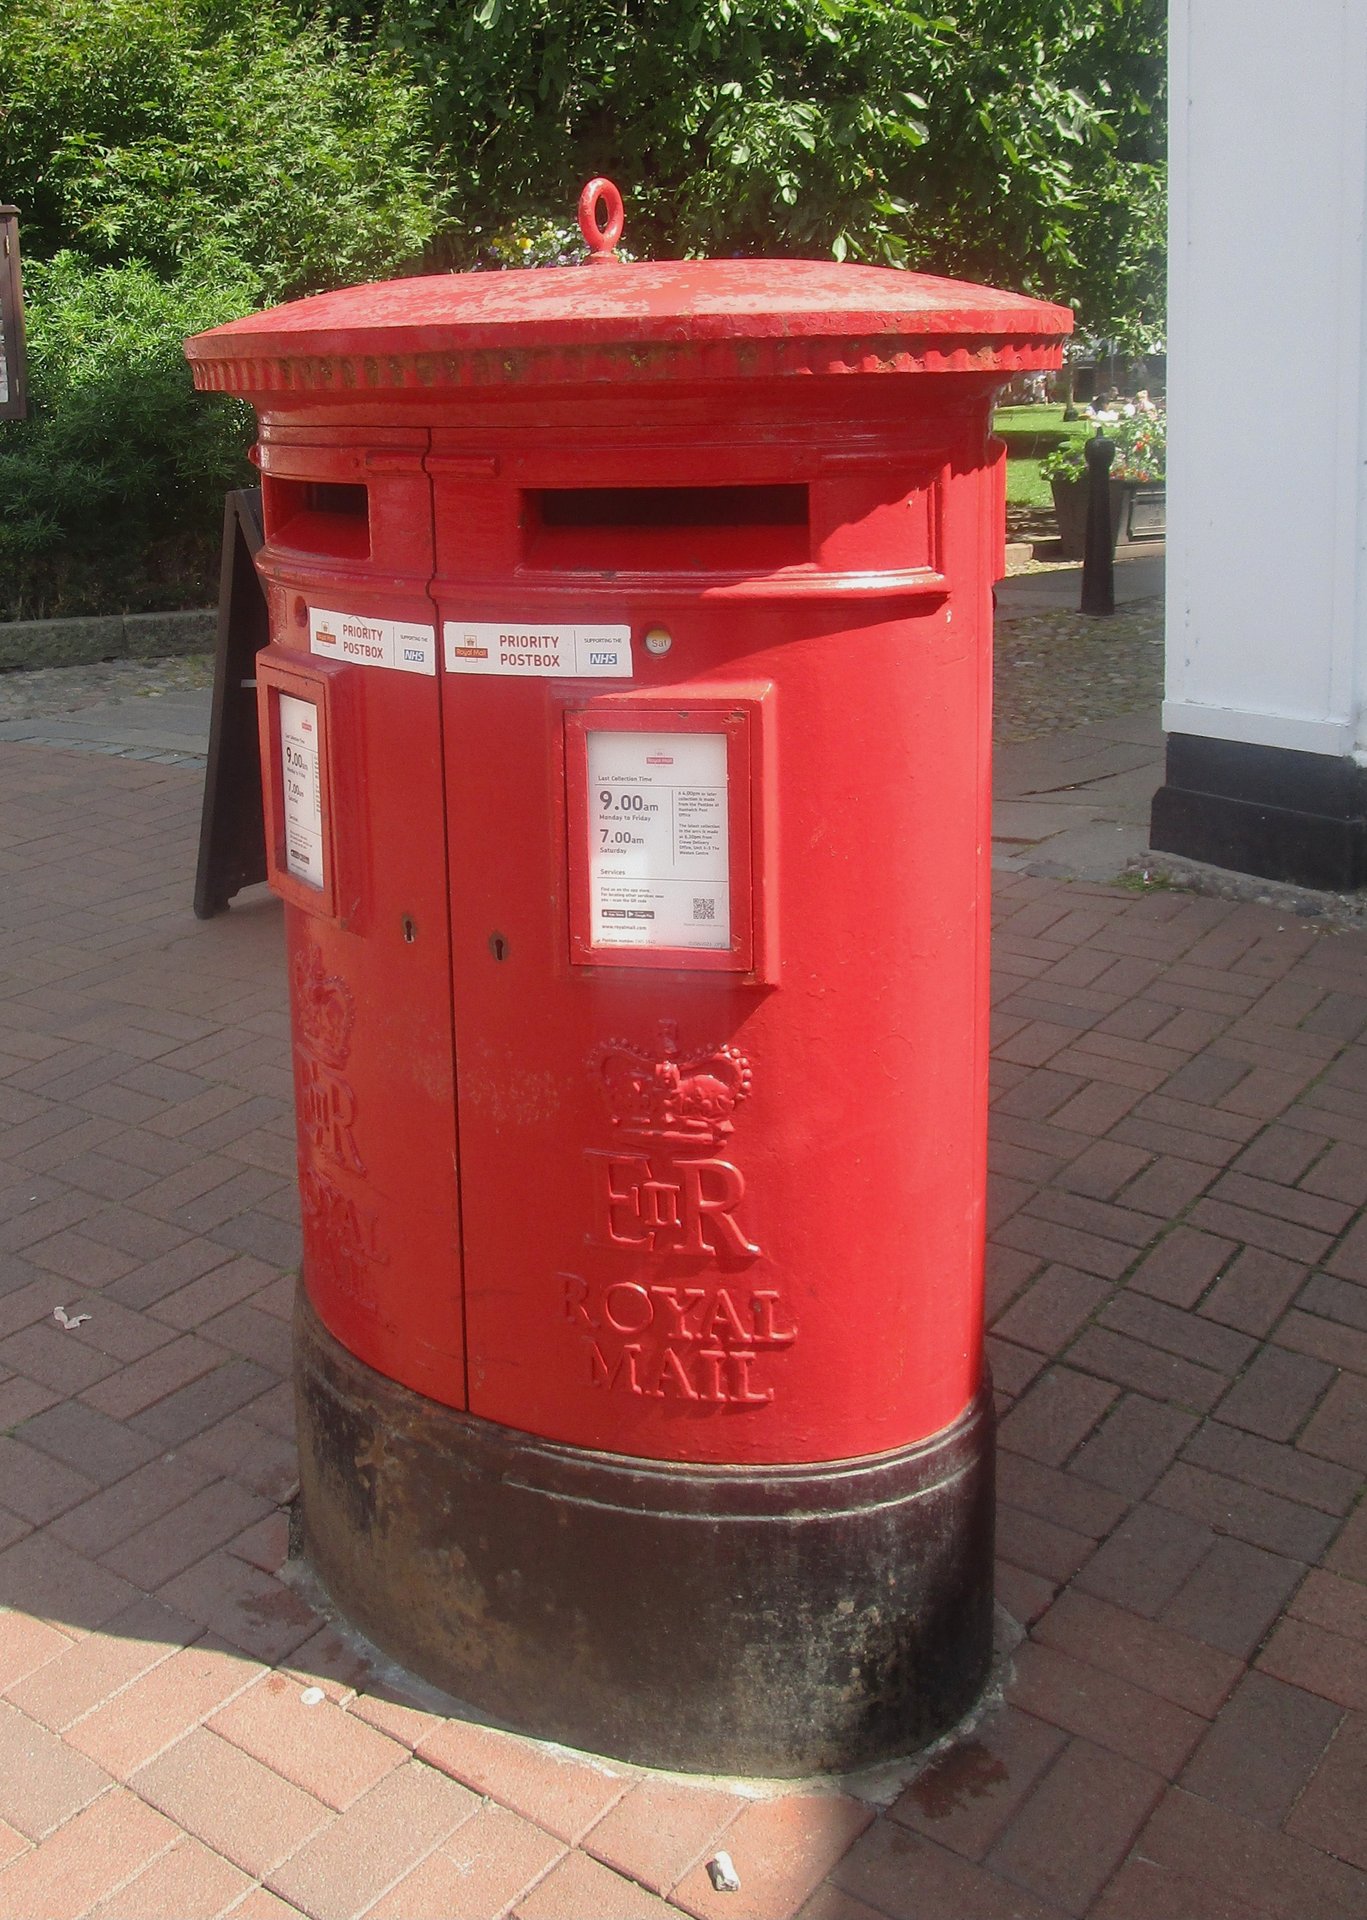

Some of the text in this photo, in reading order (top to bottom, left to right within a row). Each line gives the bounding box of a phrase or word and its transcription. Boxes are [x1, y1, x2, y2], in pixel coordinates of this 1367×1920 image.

[343, 624, 383, 641] PRIORITY
[500, 634, 559, 649] PRIORITY
[652, 639, 666, 647] Sat
[344, 642, 384, 659] POSTBOX
[404, 650, 423, 661] NHS
[500, 654, 560, 667] POSTBOX
[592, 654, 616, 664] NHS
[600, 790, 658, 811] 9.00am
[600, 829, 644, 844] 7.00am
[557, 1271, 798, 1344] ROYAL
[581, 1335, 776, 1404] MAIL
